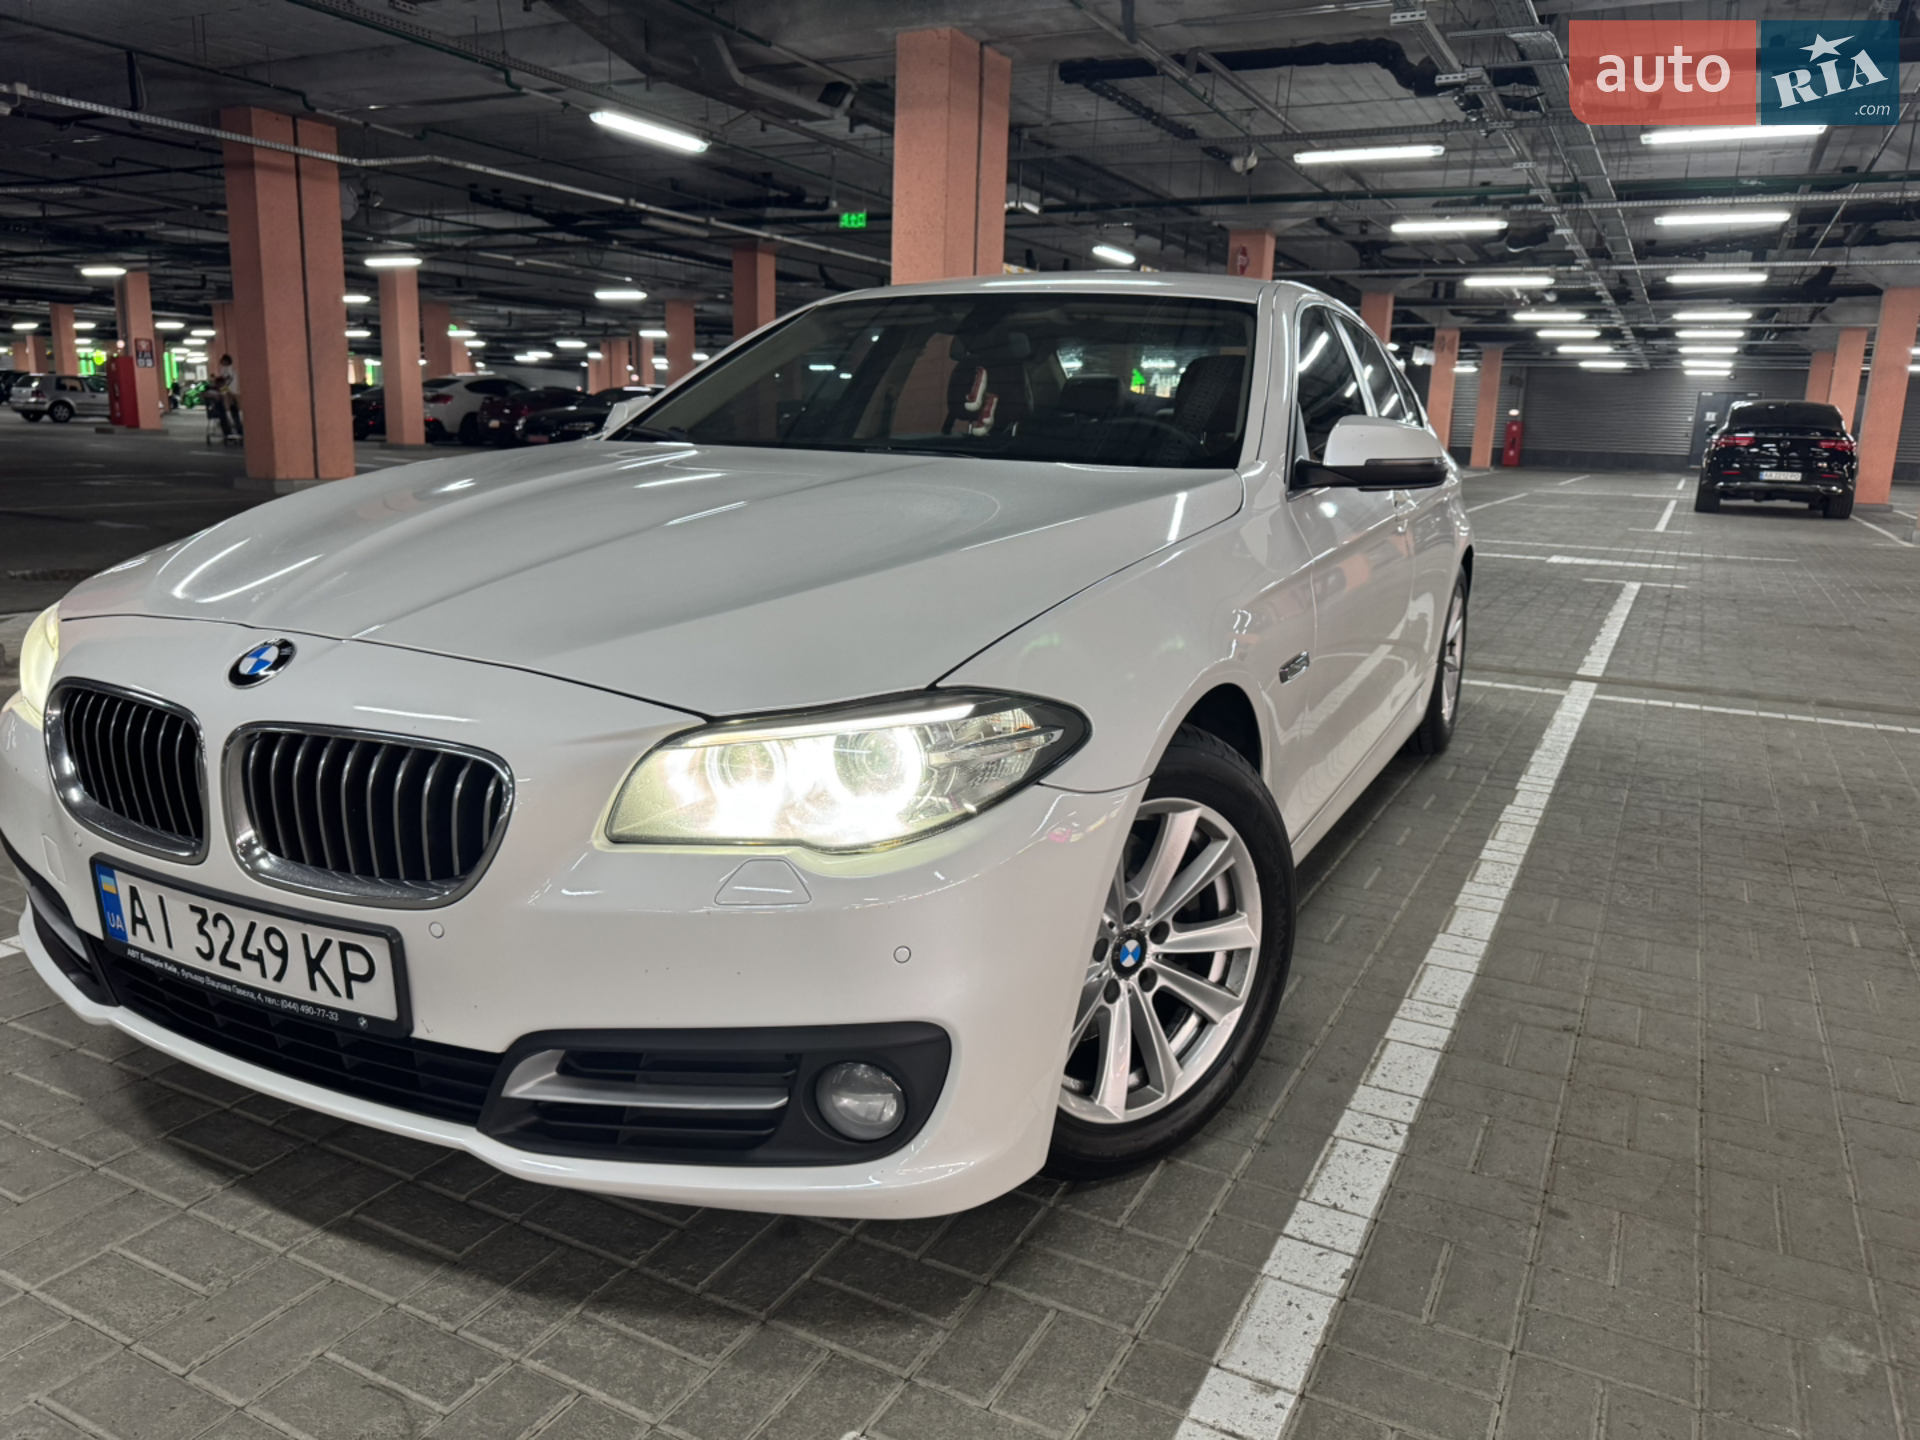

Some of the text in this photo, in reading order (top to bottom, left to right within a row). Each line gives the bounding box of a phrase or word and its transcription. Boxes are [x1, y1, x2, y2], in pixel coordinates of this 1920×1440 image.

[107, 911, 125, 931] UA
[128, 885, 377, 1001] AI 3249 KP
[281, 999, 300, 1013] (044)
[300, 1004, 339, 1021] 490-77-33
